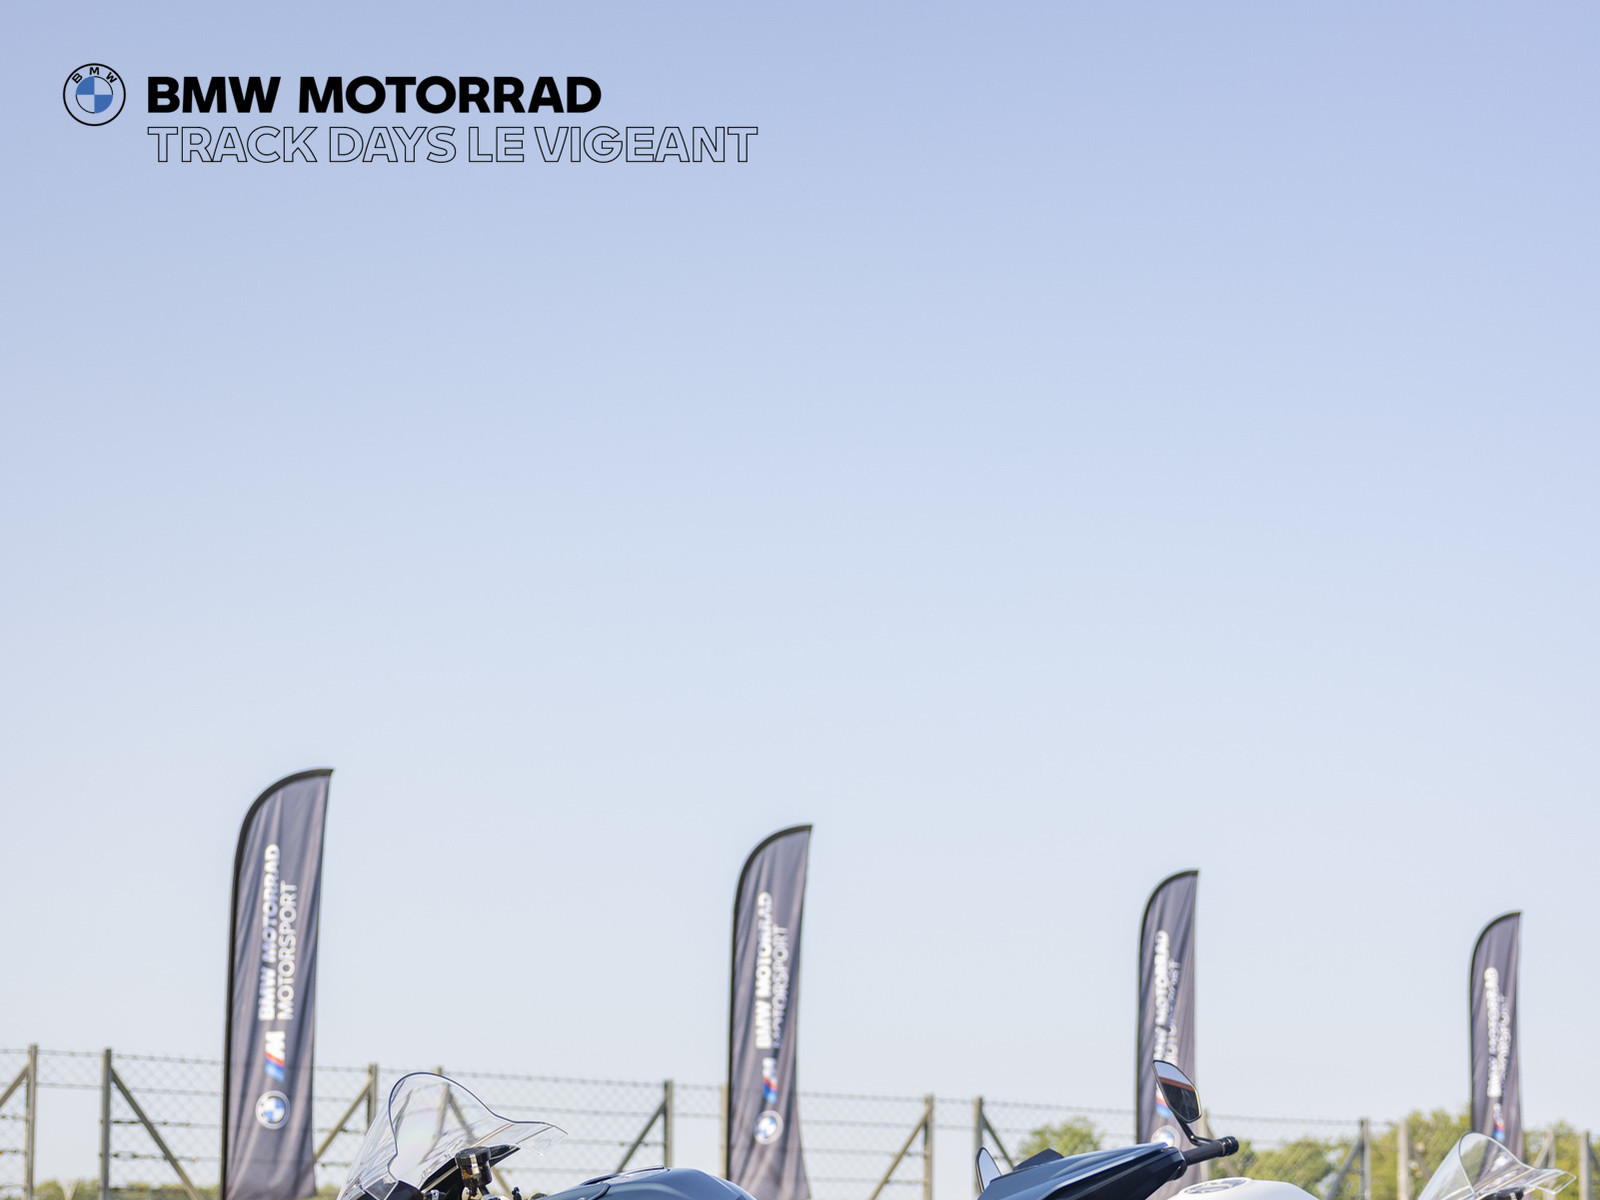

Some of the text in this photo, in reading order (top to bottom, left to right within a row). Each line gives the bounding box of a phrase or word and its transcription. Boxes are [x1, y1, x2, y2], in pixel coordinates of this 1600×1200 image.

[258, 843, 280, 1021] BMW MOTORRAD
[277, 881, 297, 1020] MOTORSPORT
